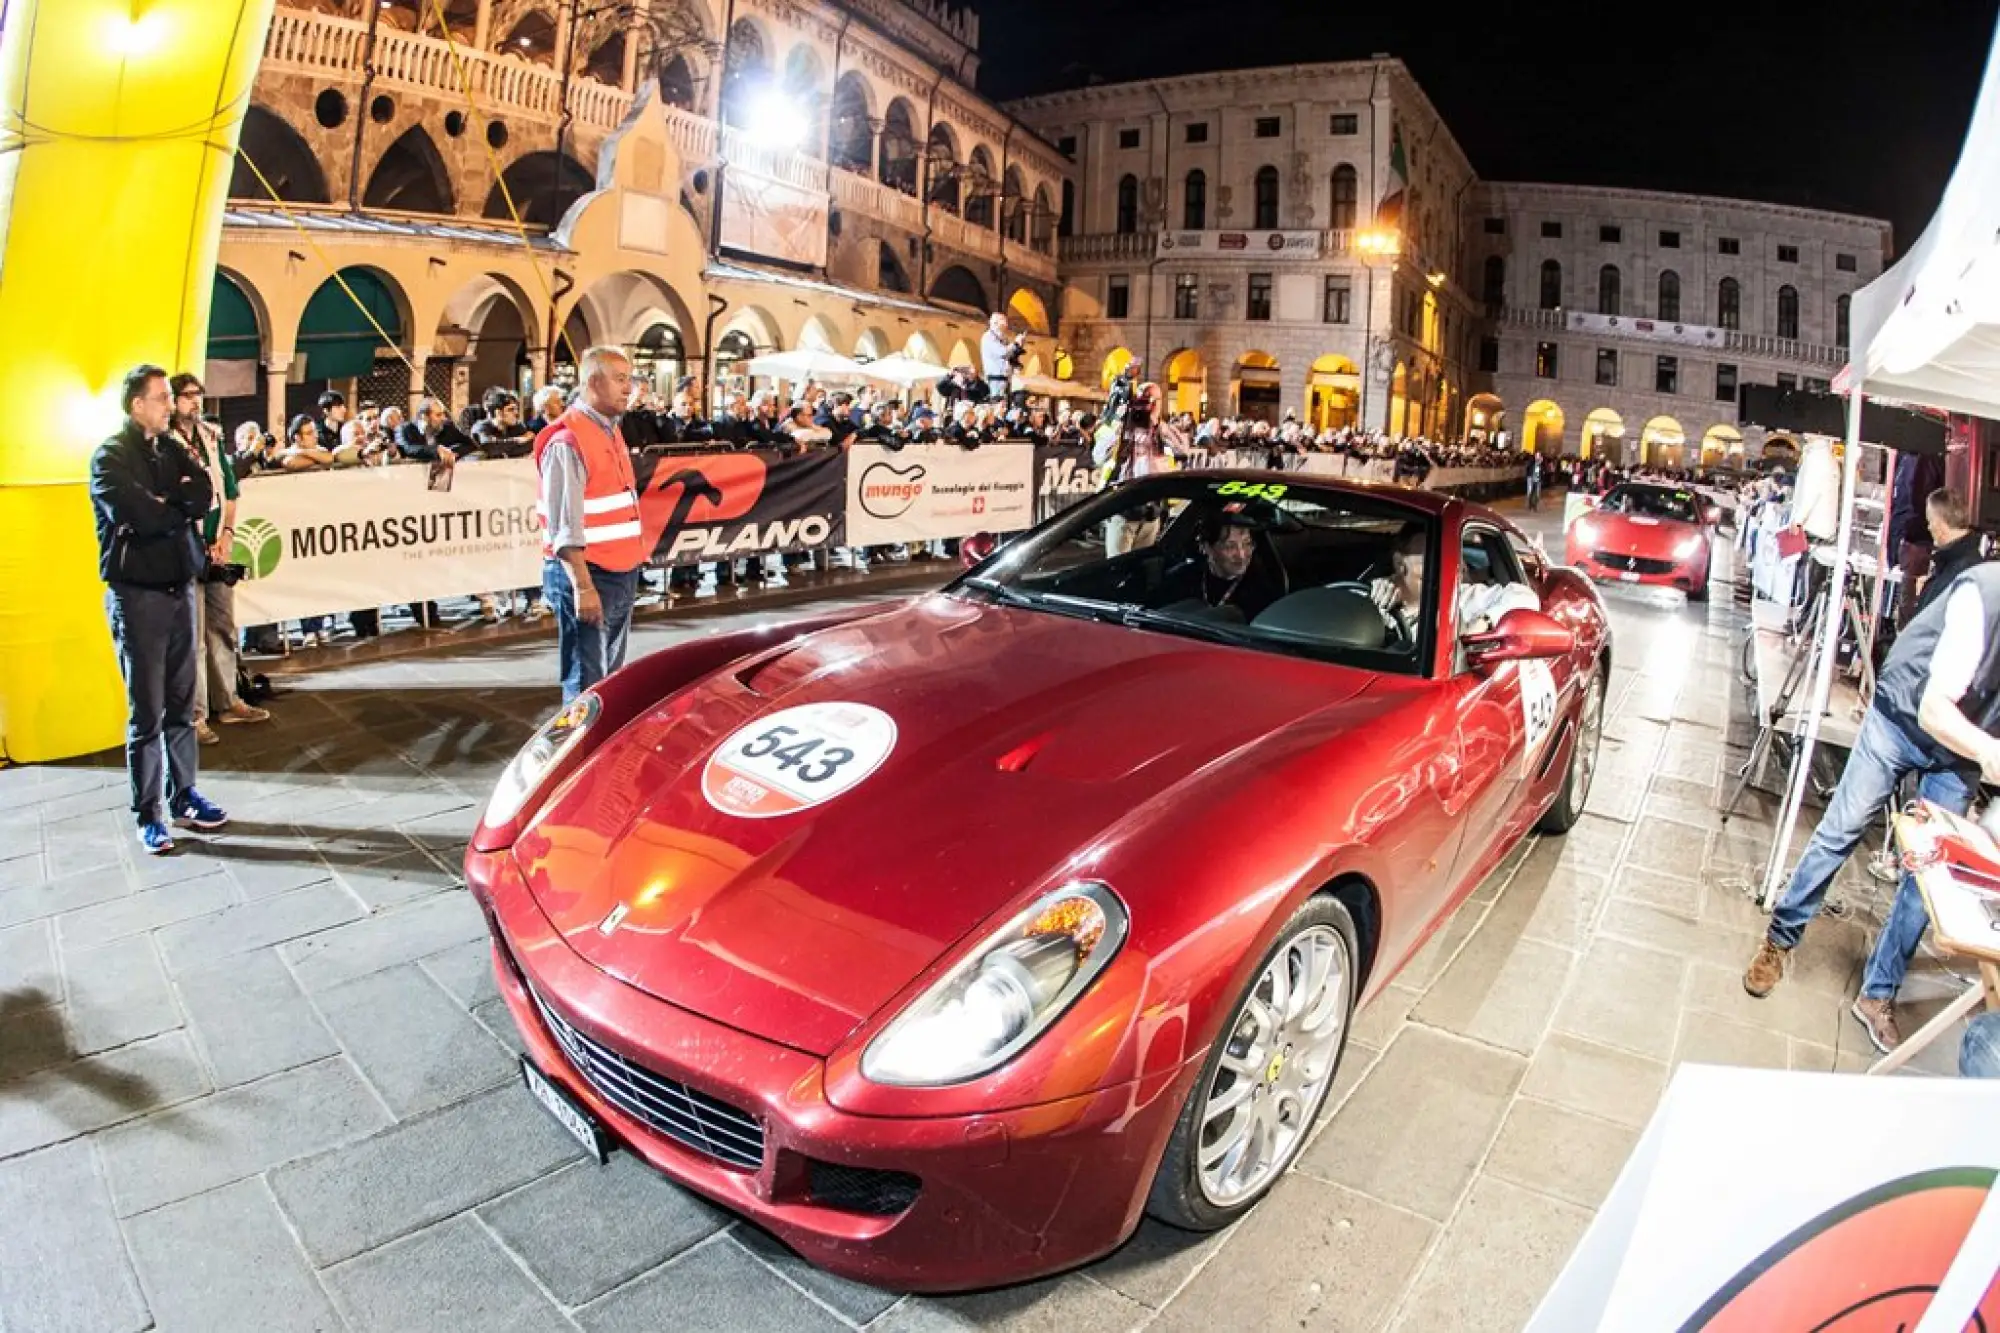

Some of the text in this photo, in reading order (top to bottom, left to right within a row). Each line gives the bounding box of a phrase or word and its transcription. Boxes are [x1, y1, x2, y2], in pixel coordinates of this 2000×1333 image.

[865, 484, 922, 501] mungo
[1217, 482, 1288, 503] 543
[291, 509, 482, 559] MORASSUTTI
[429, 540, 513, 556] PROFESSIONAL
[666, 515, 830, 560] PLANO
[741, 726, 855, 783] 543
